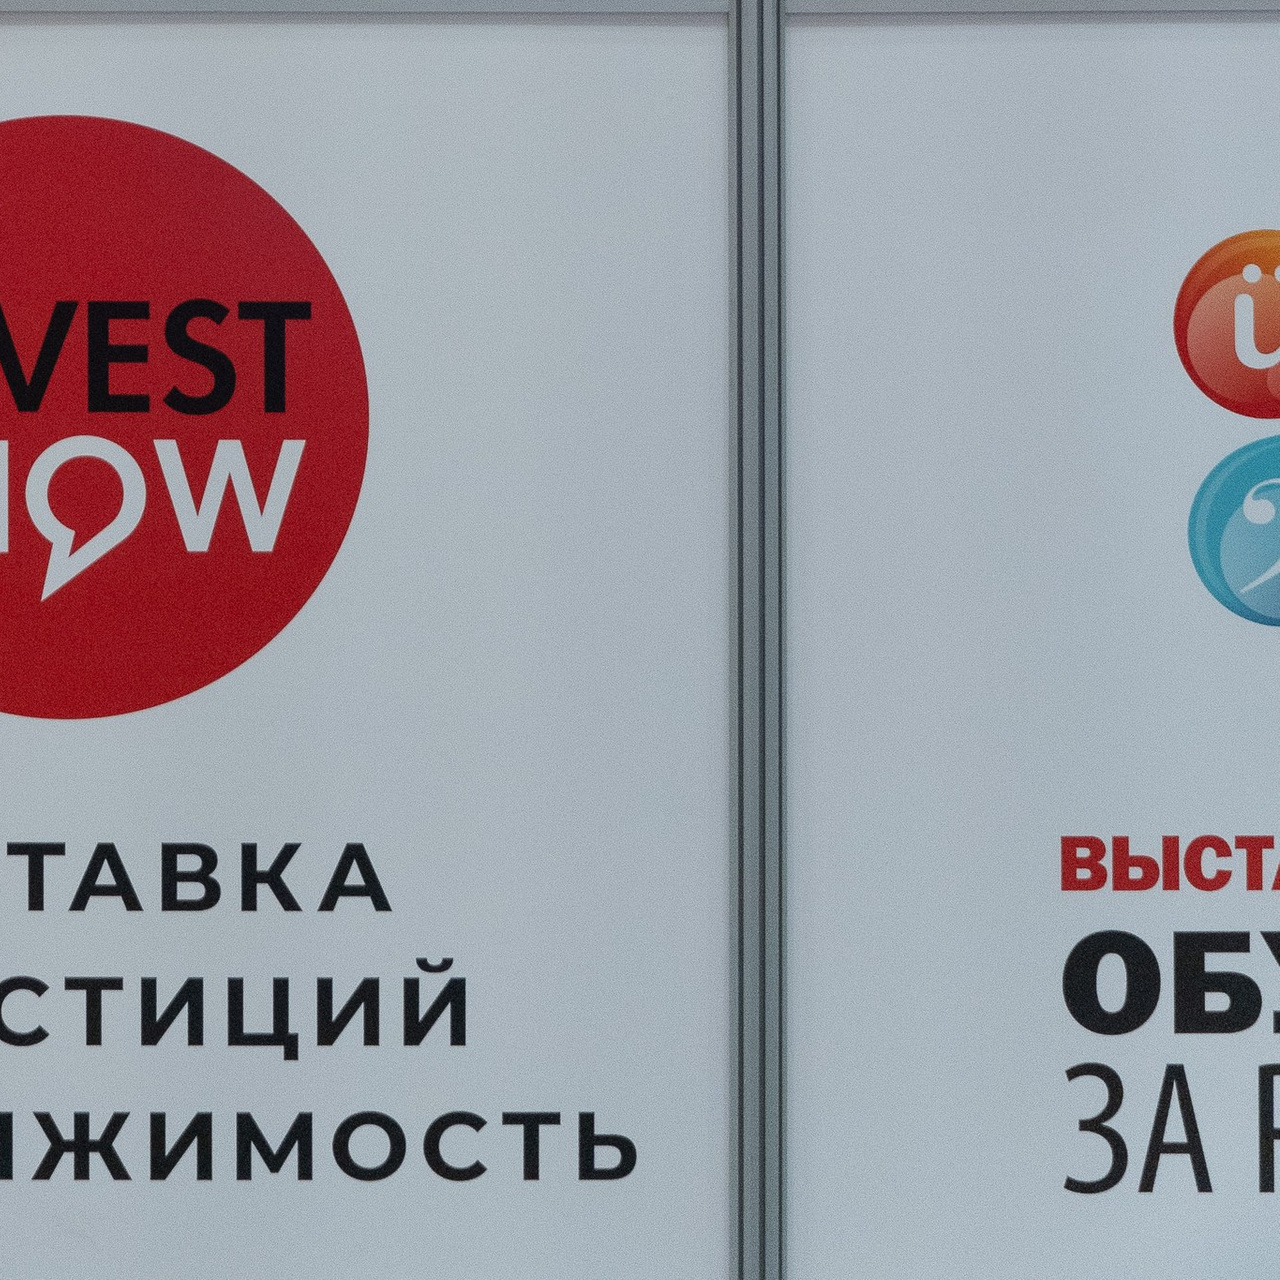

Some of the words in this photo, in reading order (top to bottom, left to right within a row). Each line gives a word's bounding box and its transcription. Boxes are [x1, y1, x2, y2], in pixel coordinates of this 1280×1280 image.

[1061, 835, 1280, 892] ВЫСТ
[1062, 930, 1280, 1035] ОБ
[1064, 1062, 1213, 1195] ЗА
